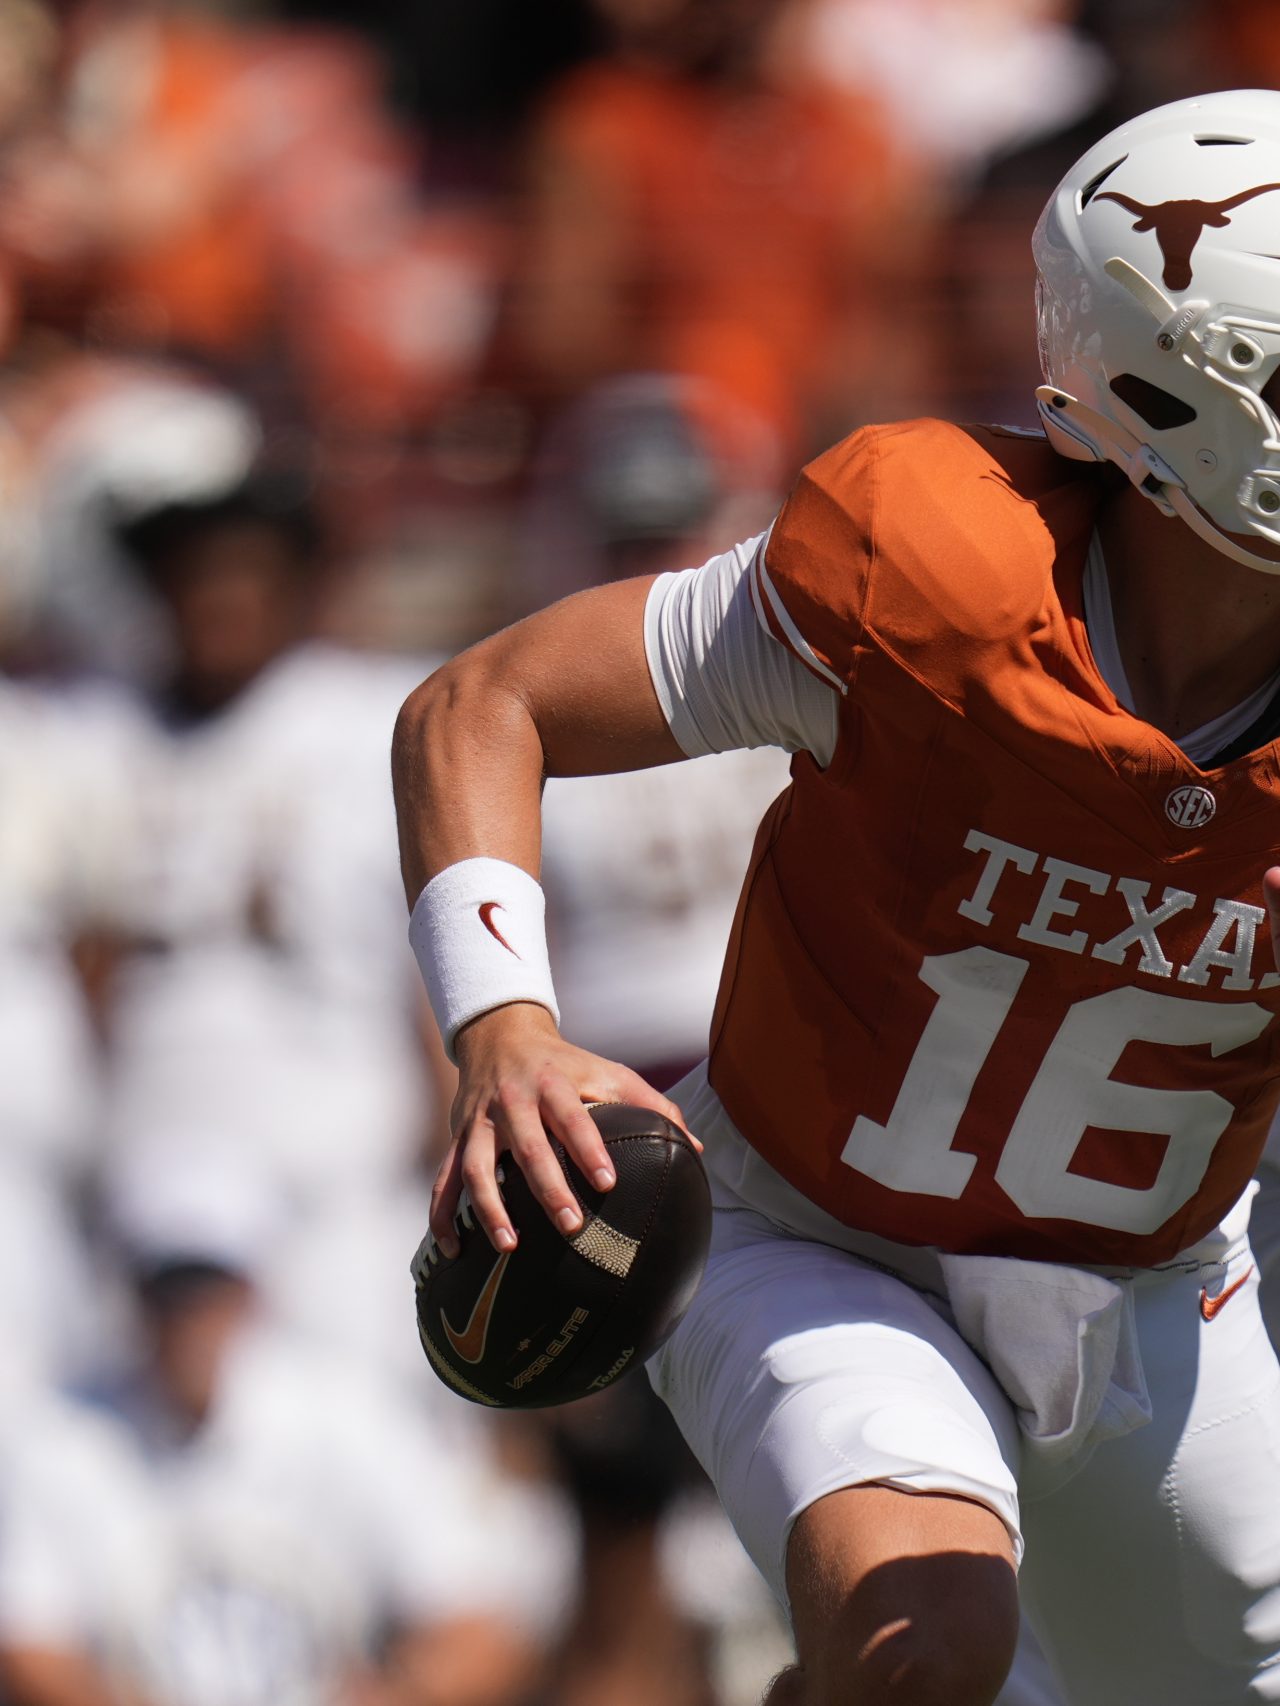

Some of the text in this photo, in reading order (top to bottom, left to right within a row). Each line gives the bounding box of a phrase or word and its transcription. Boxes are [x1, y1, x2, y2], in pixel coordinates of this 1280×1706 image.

[1169, 789, 1212, 826] SEC
[957, 828, 1280, 991] TEXA
[840, 945, 1275, 1236] 16
[506, 1307, 589, 1389] VAPOR ELITE
[587, 1347, 634, 1389] Texas
